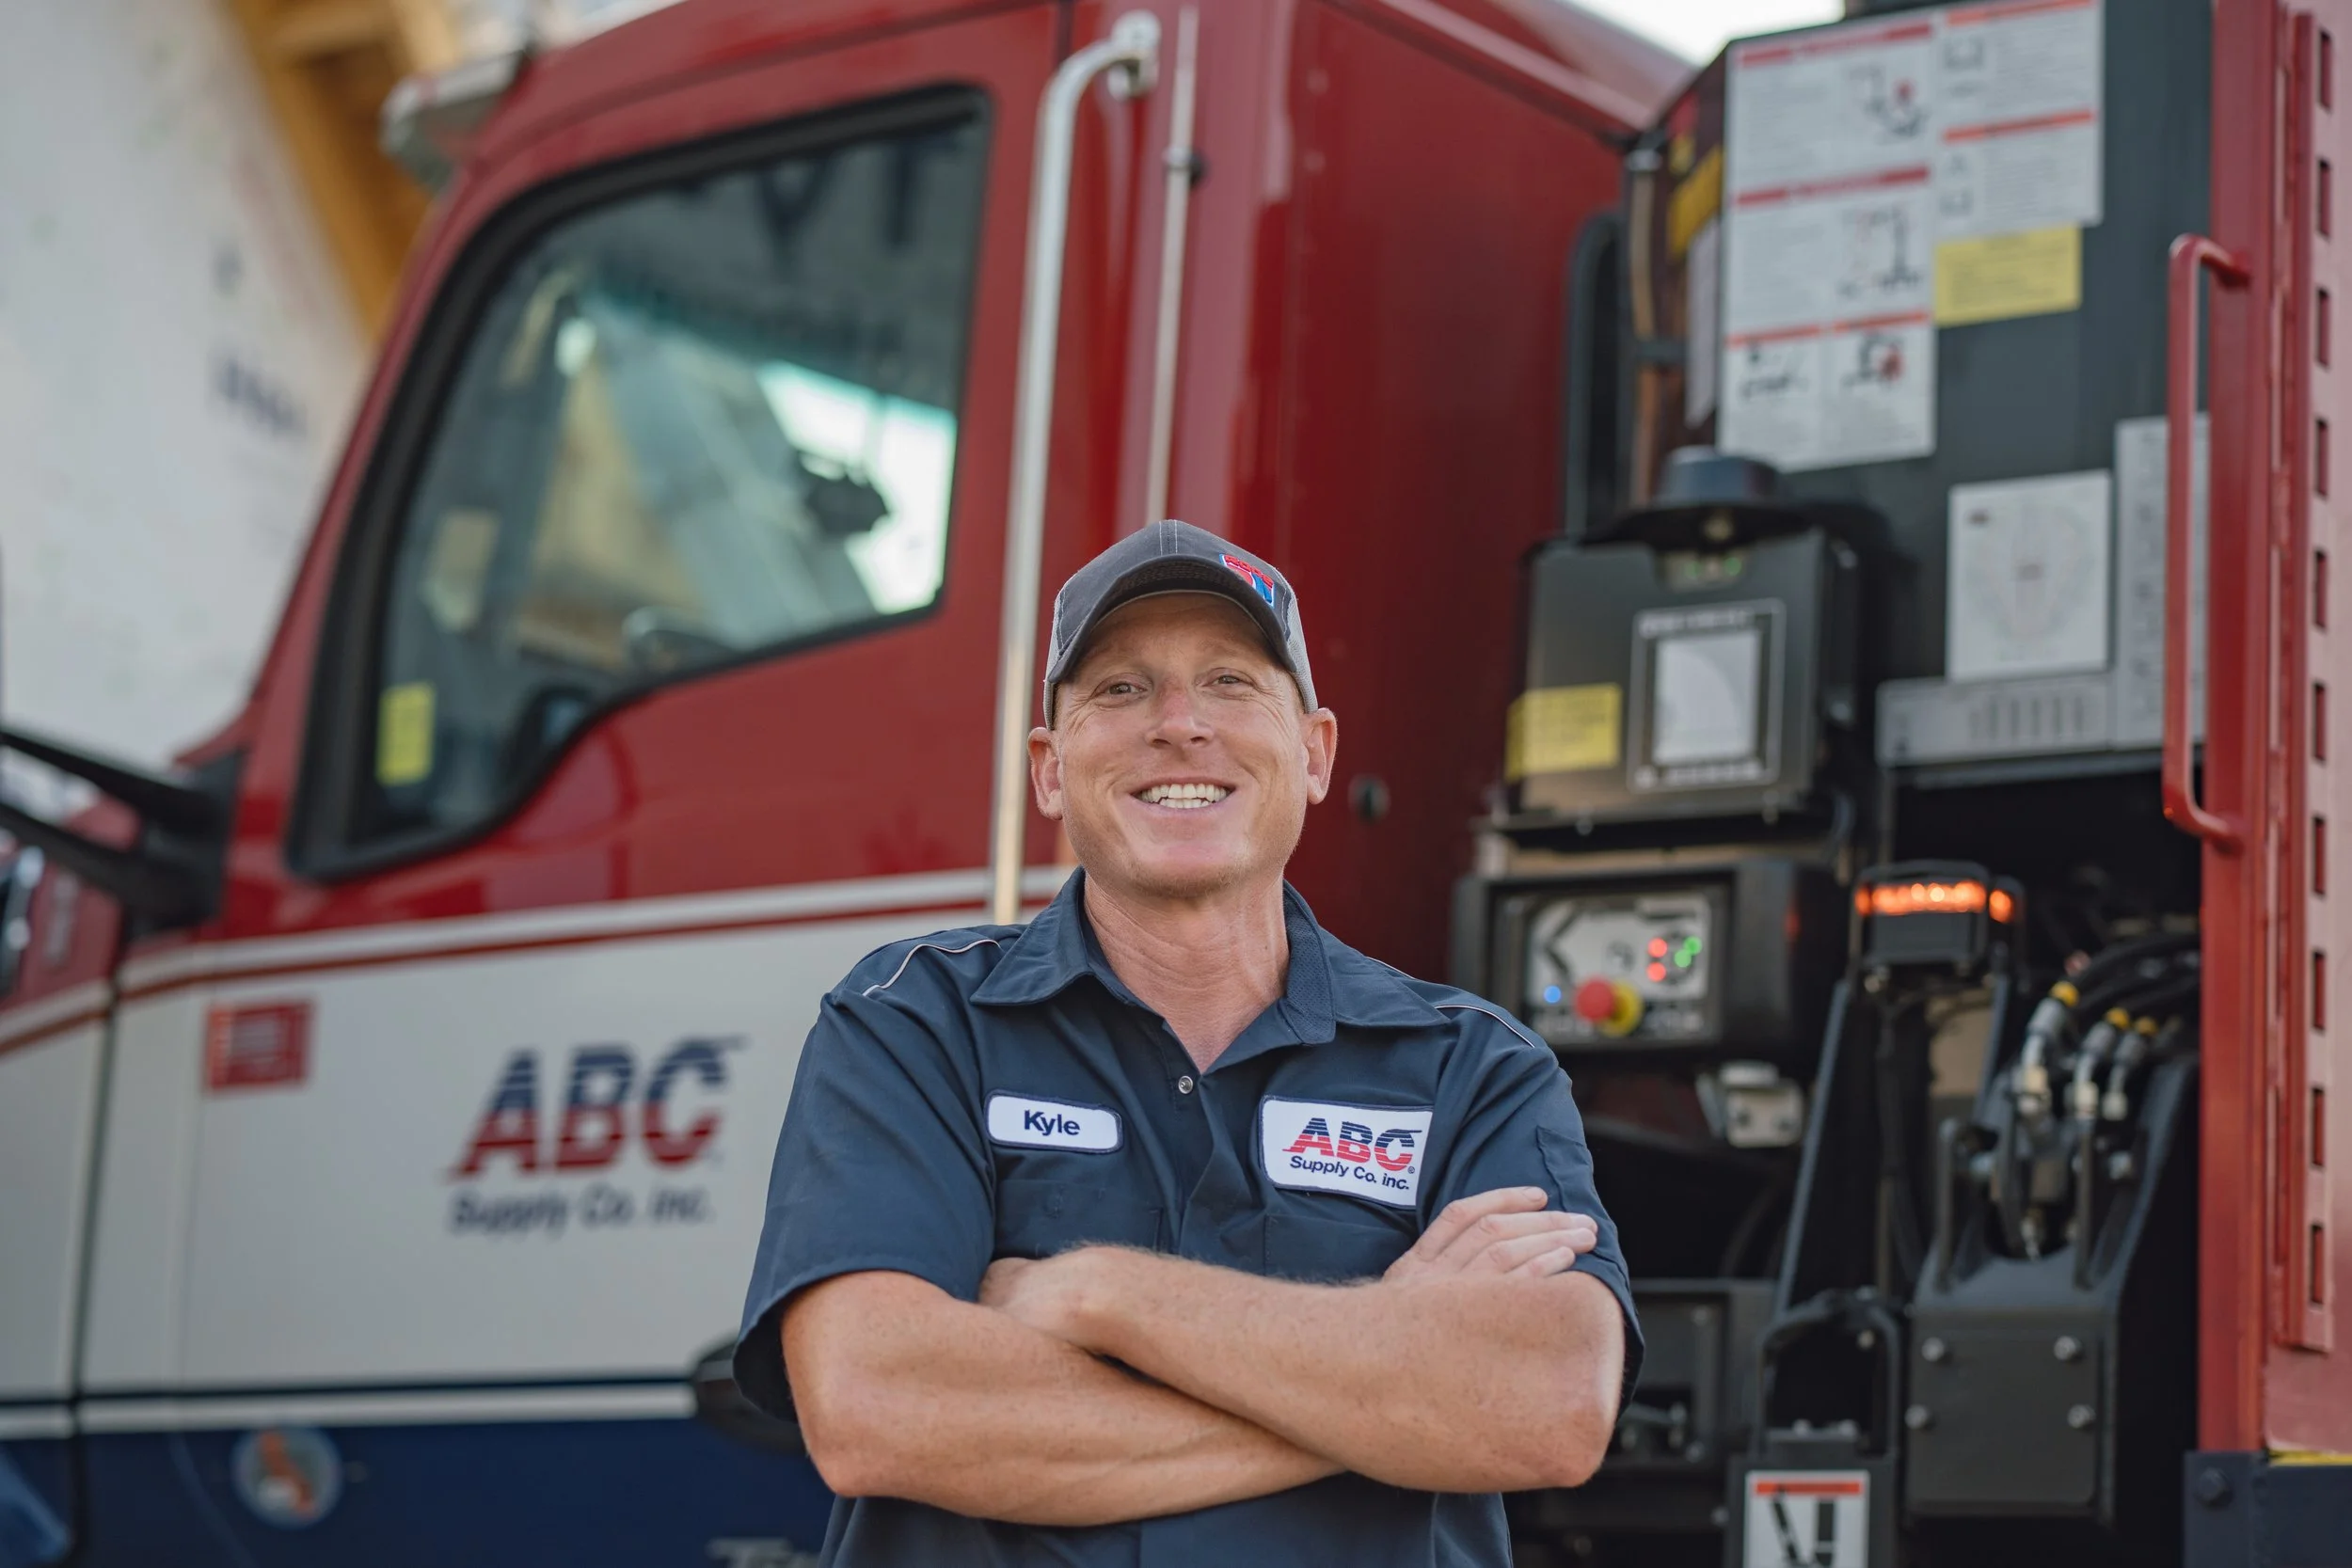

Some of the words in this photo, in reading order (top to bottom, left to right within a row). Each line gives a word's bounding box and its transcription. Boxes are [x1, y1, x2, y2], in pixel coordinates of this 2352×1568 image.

[442, 1037, 746, 1180] ABC
[1025, 1109, 1081, 1136] Kyle
[1282, 1117, 1422, 1171] ABC
[1290, 1155, 1349, 1177] Supply
[1353, 1165, 1377, 1183] Co.
[1381, 1172, 1409, 1190] inc.
